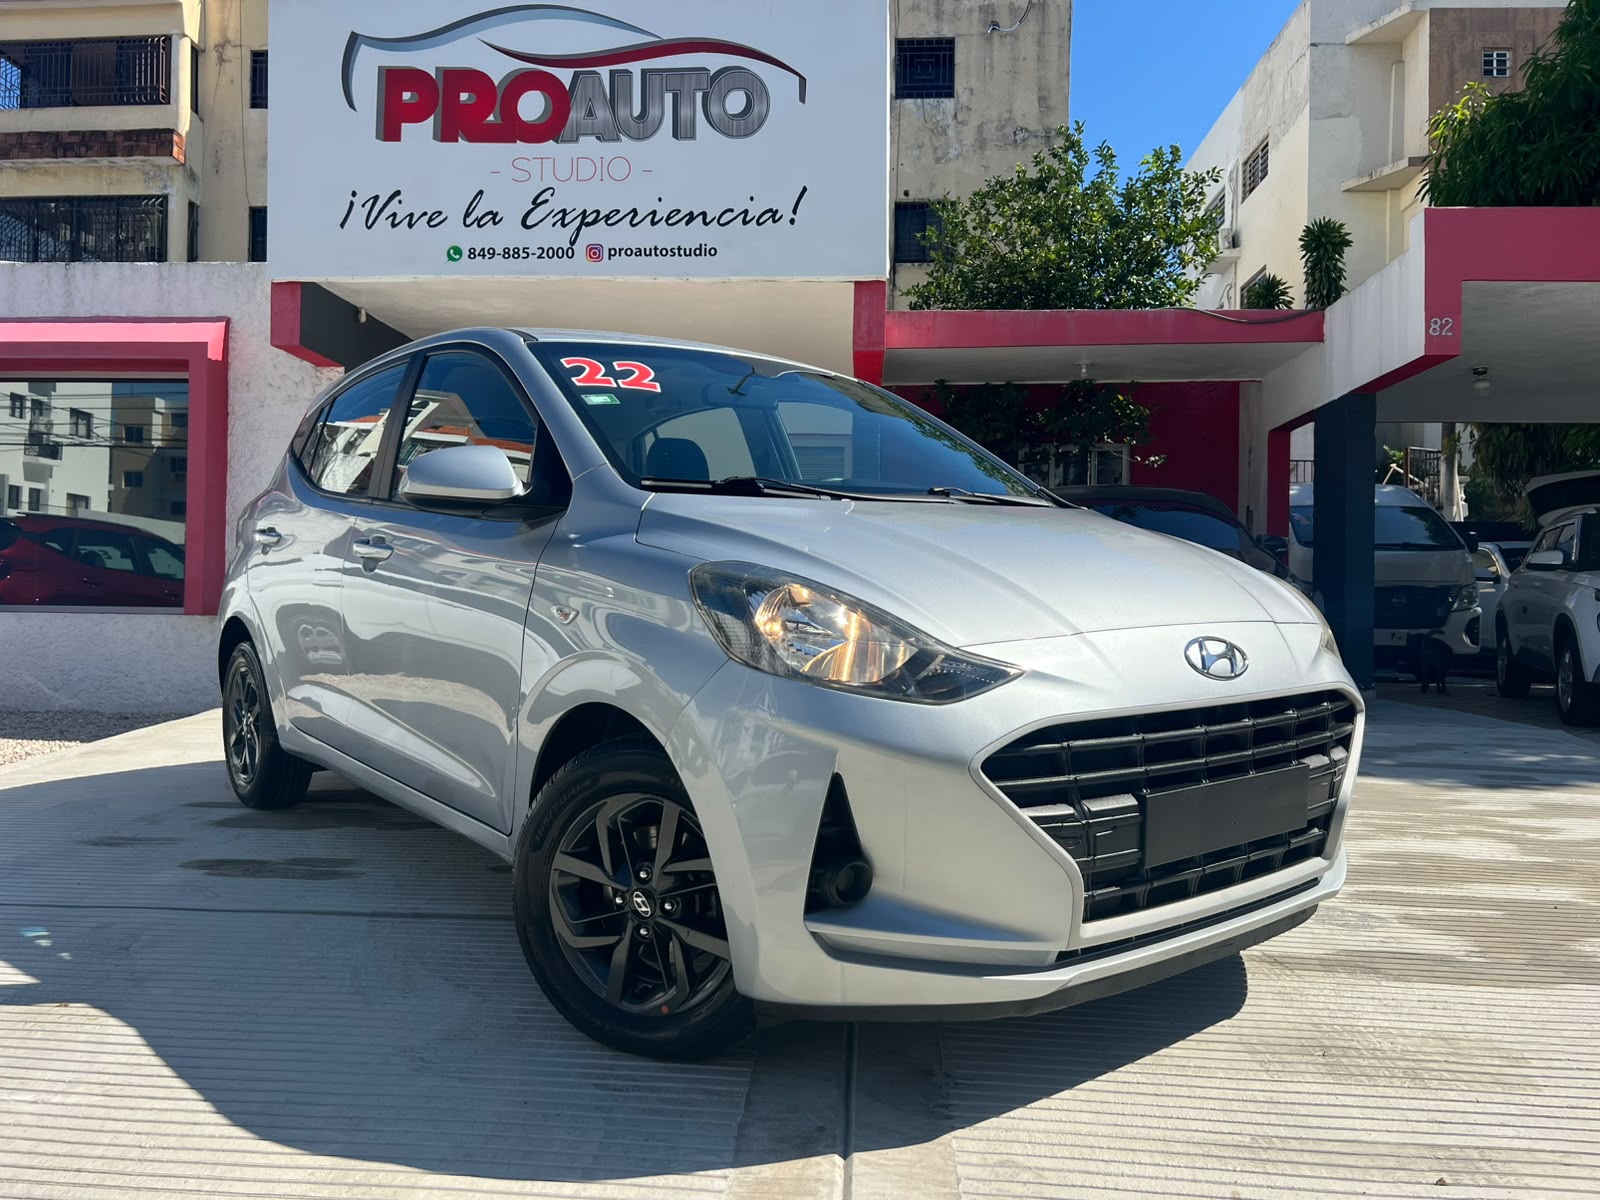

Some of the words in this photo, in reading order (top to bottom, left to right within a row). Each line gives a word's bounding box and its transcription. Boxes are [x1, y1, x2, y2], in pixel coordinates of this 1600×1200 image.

[340, 189, 448, 230] ¡Vive
[463, 189, 503, 228] la
[520, 185, 807, 246] Experiencia!
[467, 247, 575, 260] 849-885-2000
[608, 243, 717, 260] proautostudio
[1429, 317, 1453, 336] 82
[560, 357, 662, 392] 22
